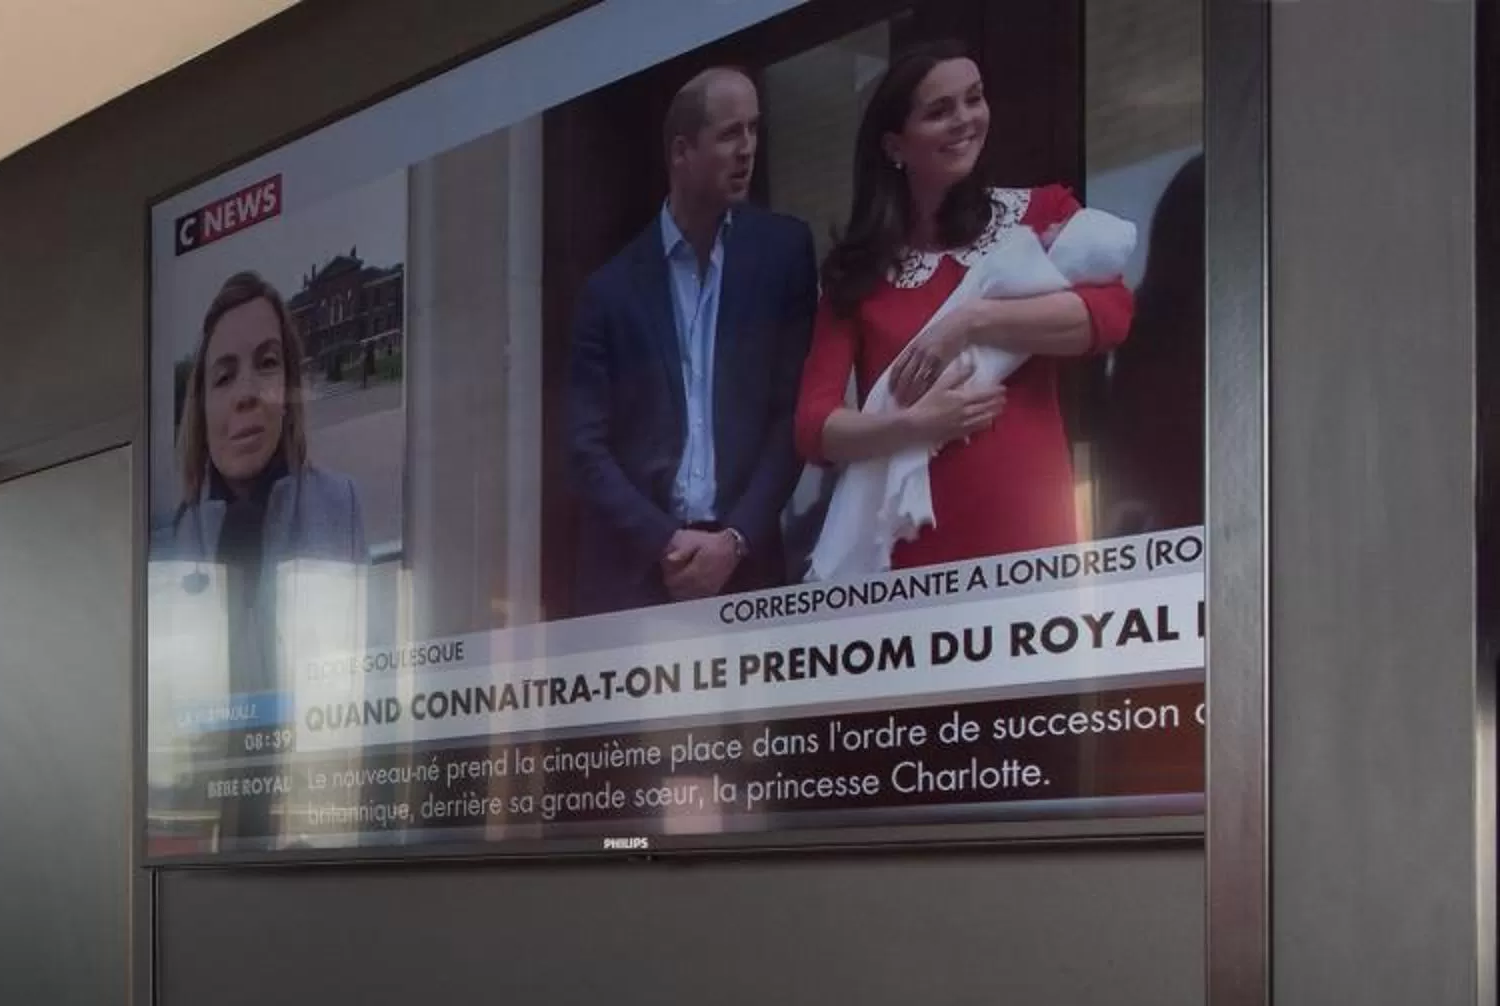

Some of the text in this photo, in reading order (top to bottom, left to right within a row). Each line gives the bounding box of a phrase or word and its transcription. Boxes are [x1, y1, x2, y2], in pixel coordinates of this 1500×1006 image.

[180, 182, 277, 246] C NEWS
[719, 569, 959, 624] CORRESPONDANTE
[996, 544, 1136, 587] LONDRES
[304, 696, 401, 732] QUAND
[693, 657, 727, 690] LE
[739, 635, 916, 686] PRENOM
[931, 625, 993, 665] DU
[1010, 605, 1180, 657] ROYAL
[244, 729, 292, 752] 08:39
[307, 767, 327, 789] Le
[332, 756, 440, 785] nouveau-né
[447, 748, 507, 788] prend
[515, 748, 535, 775] la
[543, 740, 661, 778] cinquième
[671, 733, 743, 773] place
[753, 727, 819, 758] dans
[829, 715, 927, 752] l'ordre
[939, 711, 981, 744] de
[993, 698, 1180, 740] succession
[242, 775, 291, 796] ROYAL
[421, 792, 501, 818] derrière
[508, 795, 533, 814] sa
[541, 780, 626, 820] grande
[713, 773, 737, 803] la
[747, 772, 880, 811] princesse
[891, 757, 1050, 794] Charlotte.
[603, 836, 649, 850] PHILIPS
